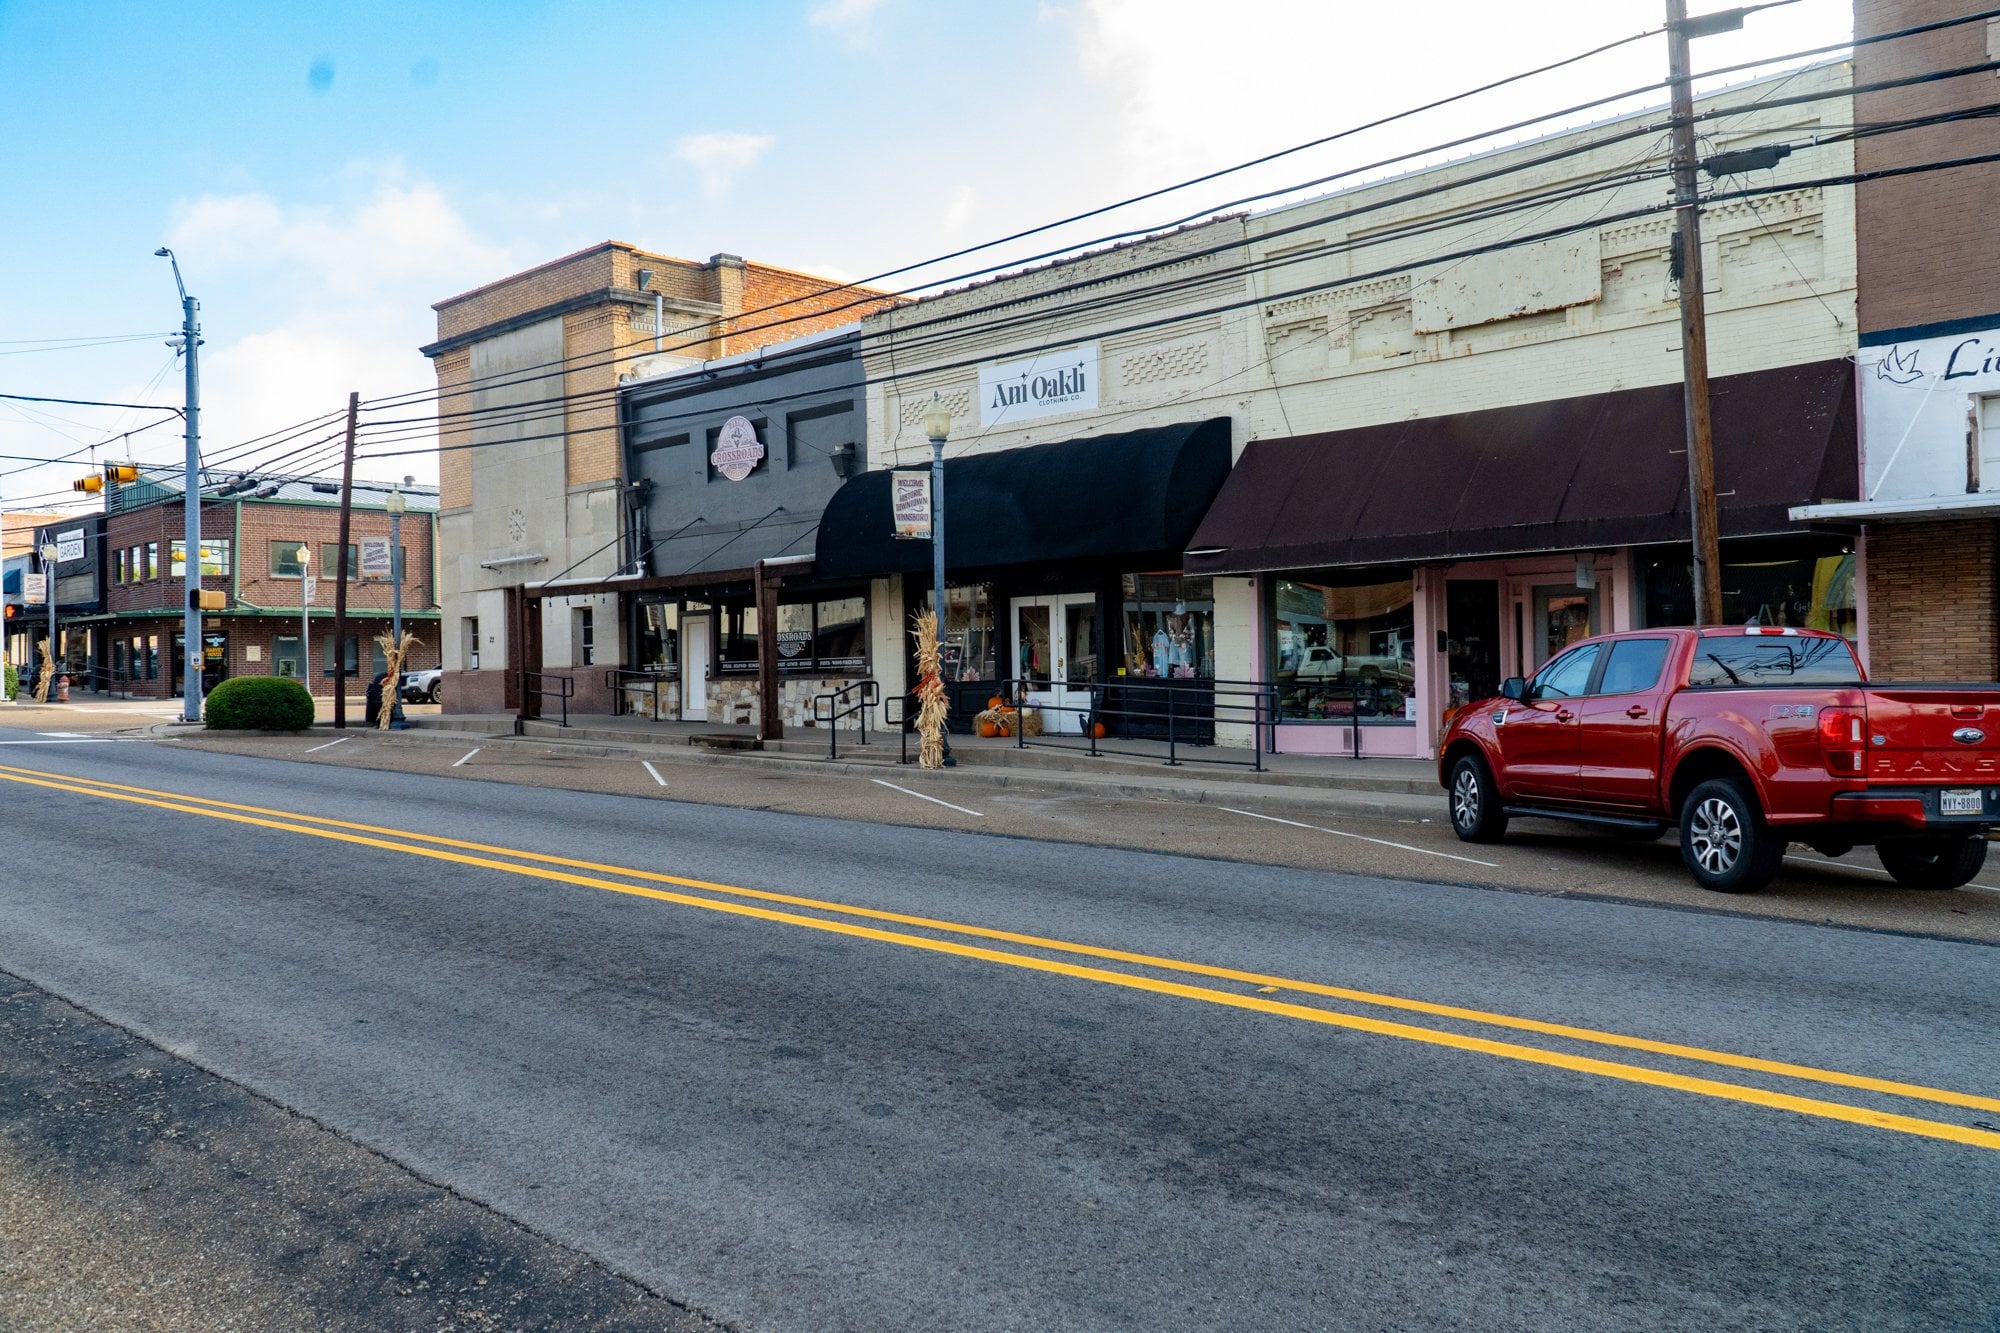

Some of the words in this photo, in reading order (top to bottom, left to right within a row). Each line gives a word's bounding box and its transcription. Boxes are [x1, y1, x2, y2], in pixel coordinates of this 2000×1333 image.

[992, 372, 1028, 408] Ani
[1032, 361, 1086, 400] Oakli
[1039, 396, 1068, 406] CLOTHING
[712, 446, 763, 464] CROSSROADS
[897, 479, 923, 487] WELCOME
[60, 543, 81, 558] GARDEN
[777, 631, 812, 641] OSSROADS
